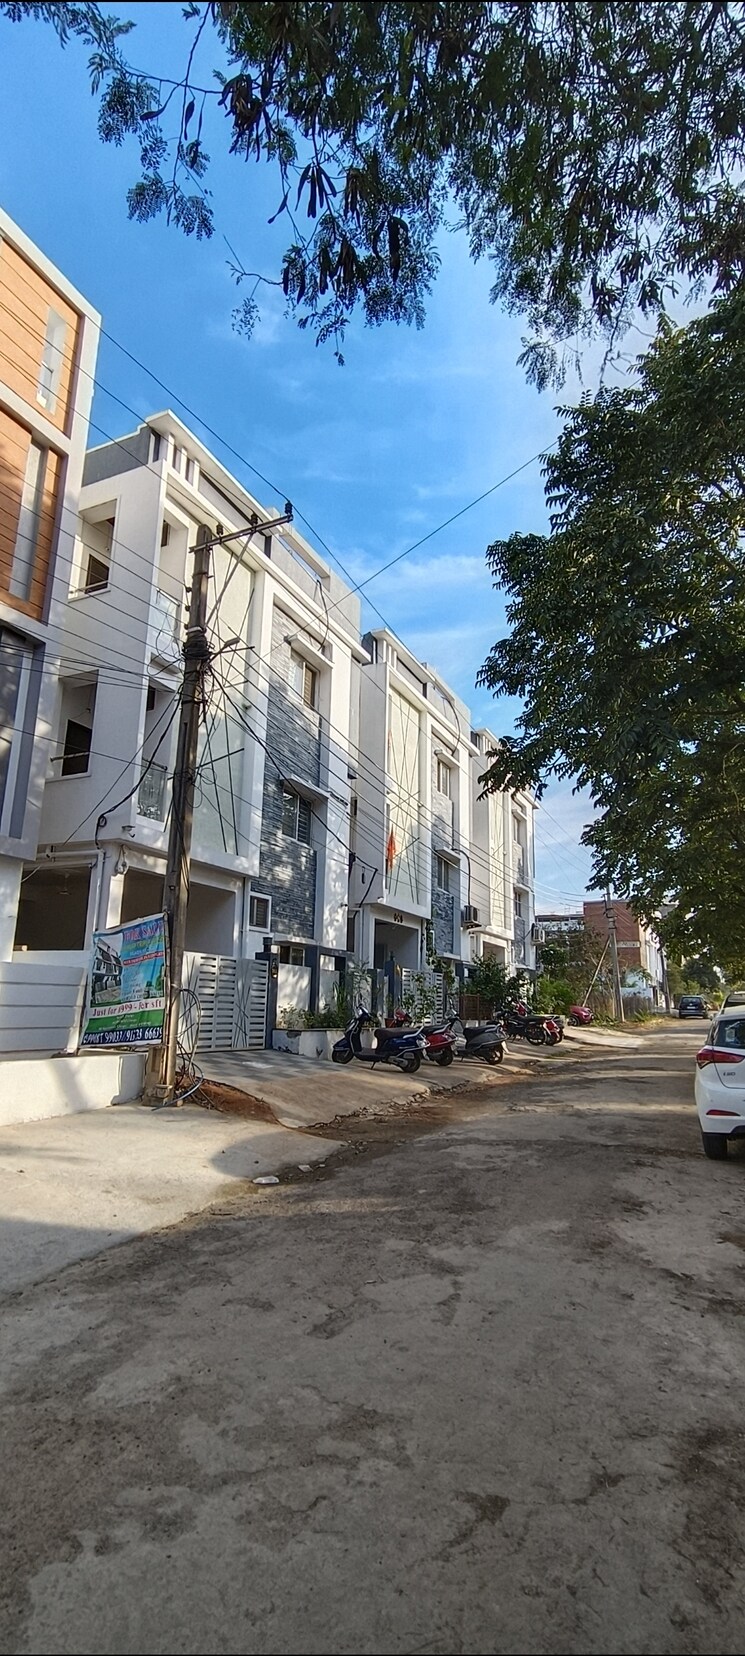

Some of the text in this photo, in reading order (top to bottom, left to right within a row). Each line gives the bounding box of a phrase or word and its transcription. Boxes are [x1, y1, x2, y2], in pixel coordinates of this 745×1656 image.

[93, 1008, 106, 1017] Just
[107, 1006, 117, 1015] for
[151, 999, 162, 1008] sft
